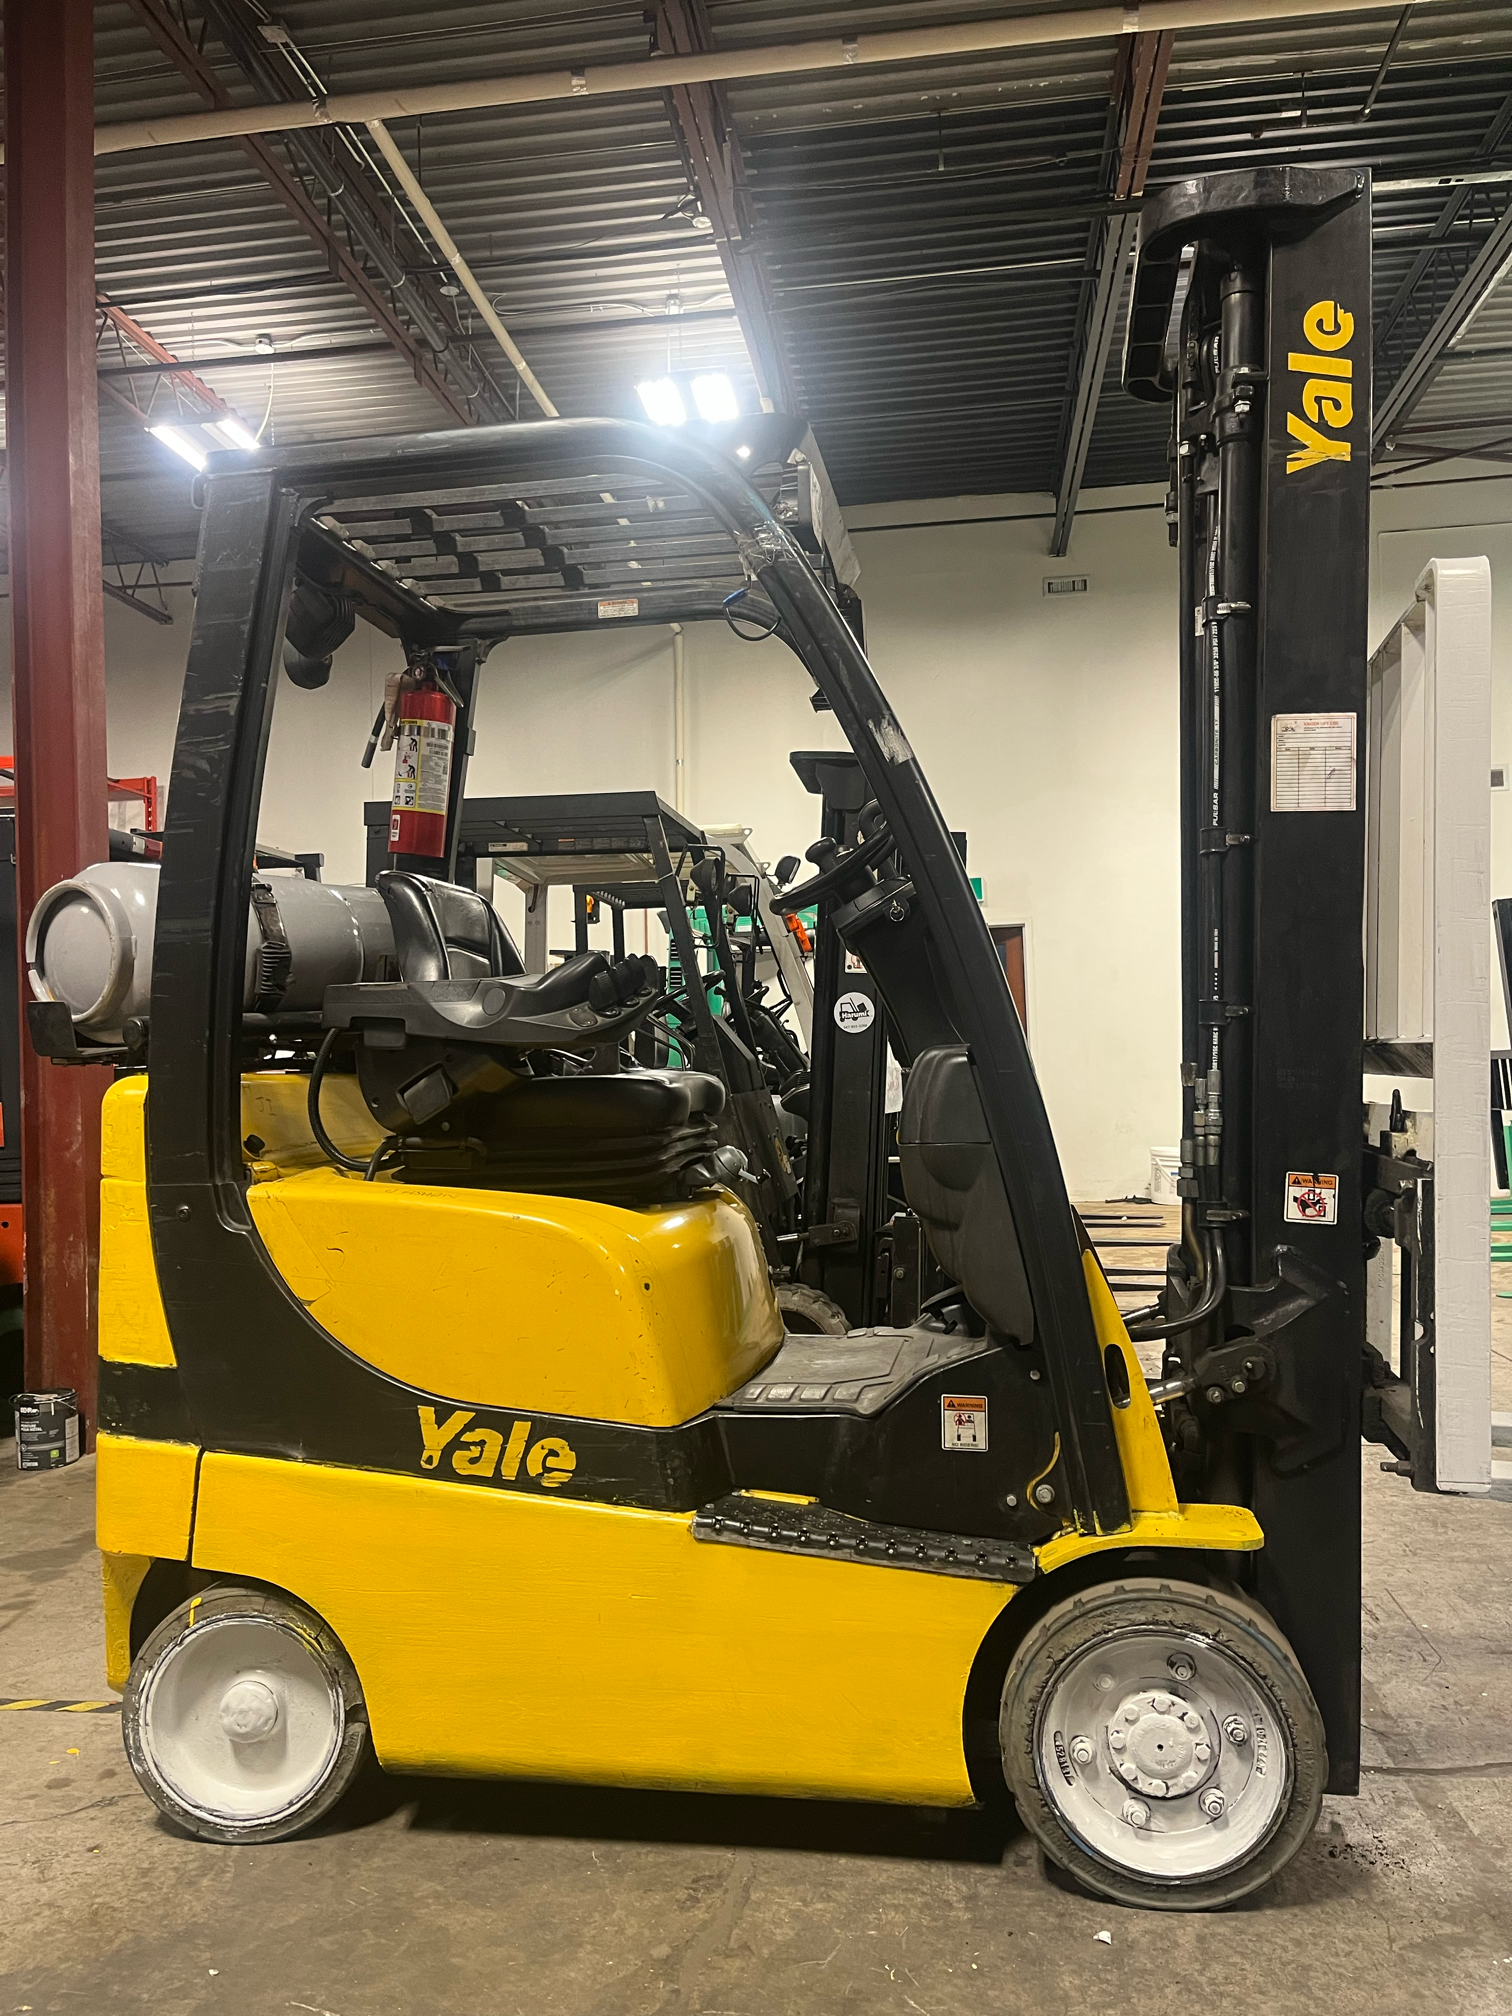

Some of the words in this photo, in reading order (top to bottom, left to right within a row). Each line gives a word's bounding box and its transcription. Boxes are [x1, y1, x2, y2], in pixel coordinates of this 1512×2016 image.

[1212, 335, 1221, 374] PULSAR
[1286, 300, 1354, 474] Yale
[841, 1010, 868, 1020] Harumi
[417, 1405, 577, 1488] Yale
